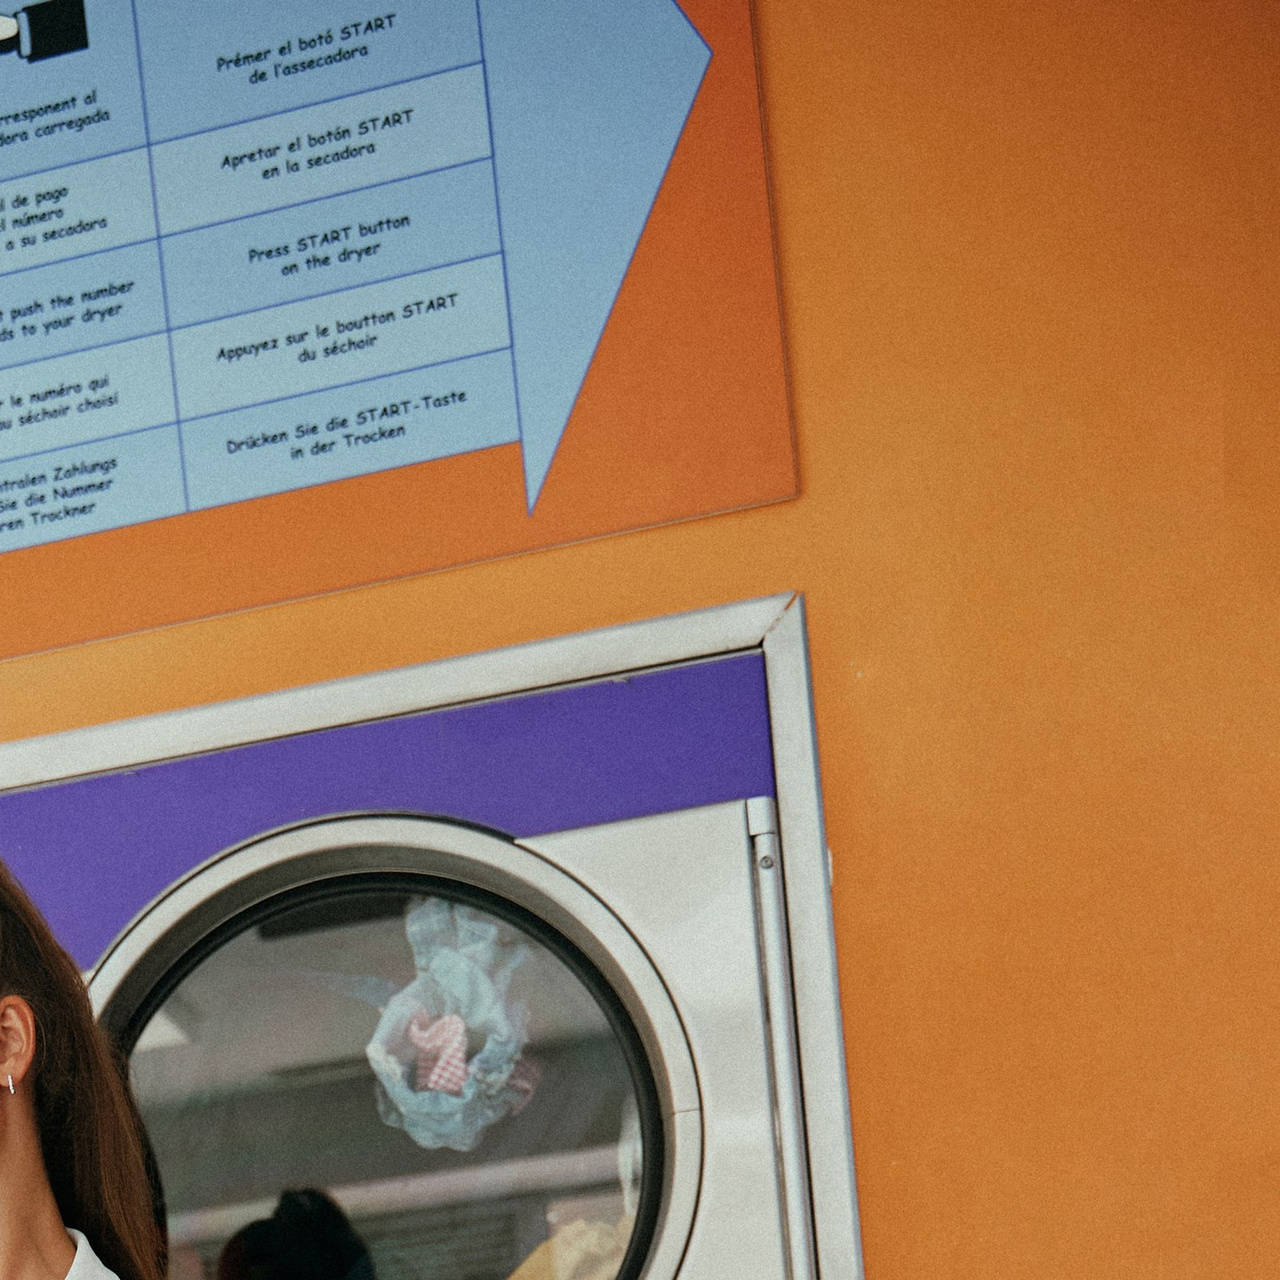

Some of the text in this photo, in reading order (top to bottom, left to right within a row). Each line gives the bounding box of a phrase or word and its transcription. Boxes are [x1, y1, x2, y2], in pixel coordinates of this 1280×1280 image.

[215, 12, 397, 73] Prémer el botó START
[247, 44, 370, 86] de l'assecadora
[82, 88, 98, 107] al
[33, 108, 111, 139] carregada
[220, 107, 415, 172] Apretar el botón START
[260, 142, 377, 181] en la secadora
[10, 194, 30, 210] de
[34, 186, 70, 208] pago
[10, 207, 65, 229] número
[19, 235, 38, 249] su
[41, 216, 109, 243] secadora
[247, 214, 412, 264] Press START button
[280, 242, 382, 277] on the dryer
[9, 299, 45, 323] push
[48, 294, 75, 310] the
[79, 280, 136, 303] number
[20, 323, 38, 337] to
[41, 314, 76, 336] your
[80, 303, 124, 324] dryer
[215, 291, 459, 364] Appuyez sur le boutton START
[296, 333, 379, 364] du séchoir
[9, 394, 24, 408] le
[28, 382, 84, 404] numéro
[87, 376, 110, 393] qui
[17, 404, 72, 428] séchoir
[225, 390, 468, 456] Drücken Sie die START-Taste
[289, 424, 407, 460] in der Trocken
[52, 457, 119, 483] Zahlungs
[24, 492, 47, 508] die
[52, 477, 115, 500] Nummer
[29, 501, 97, 524] Trockner
